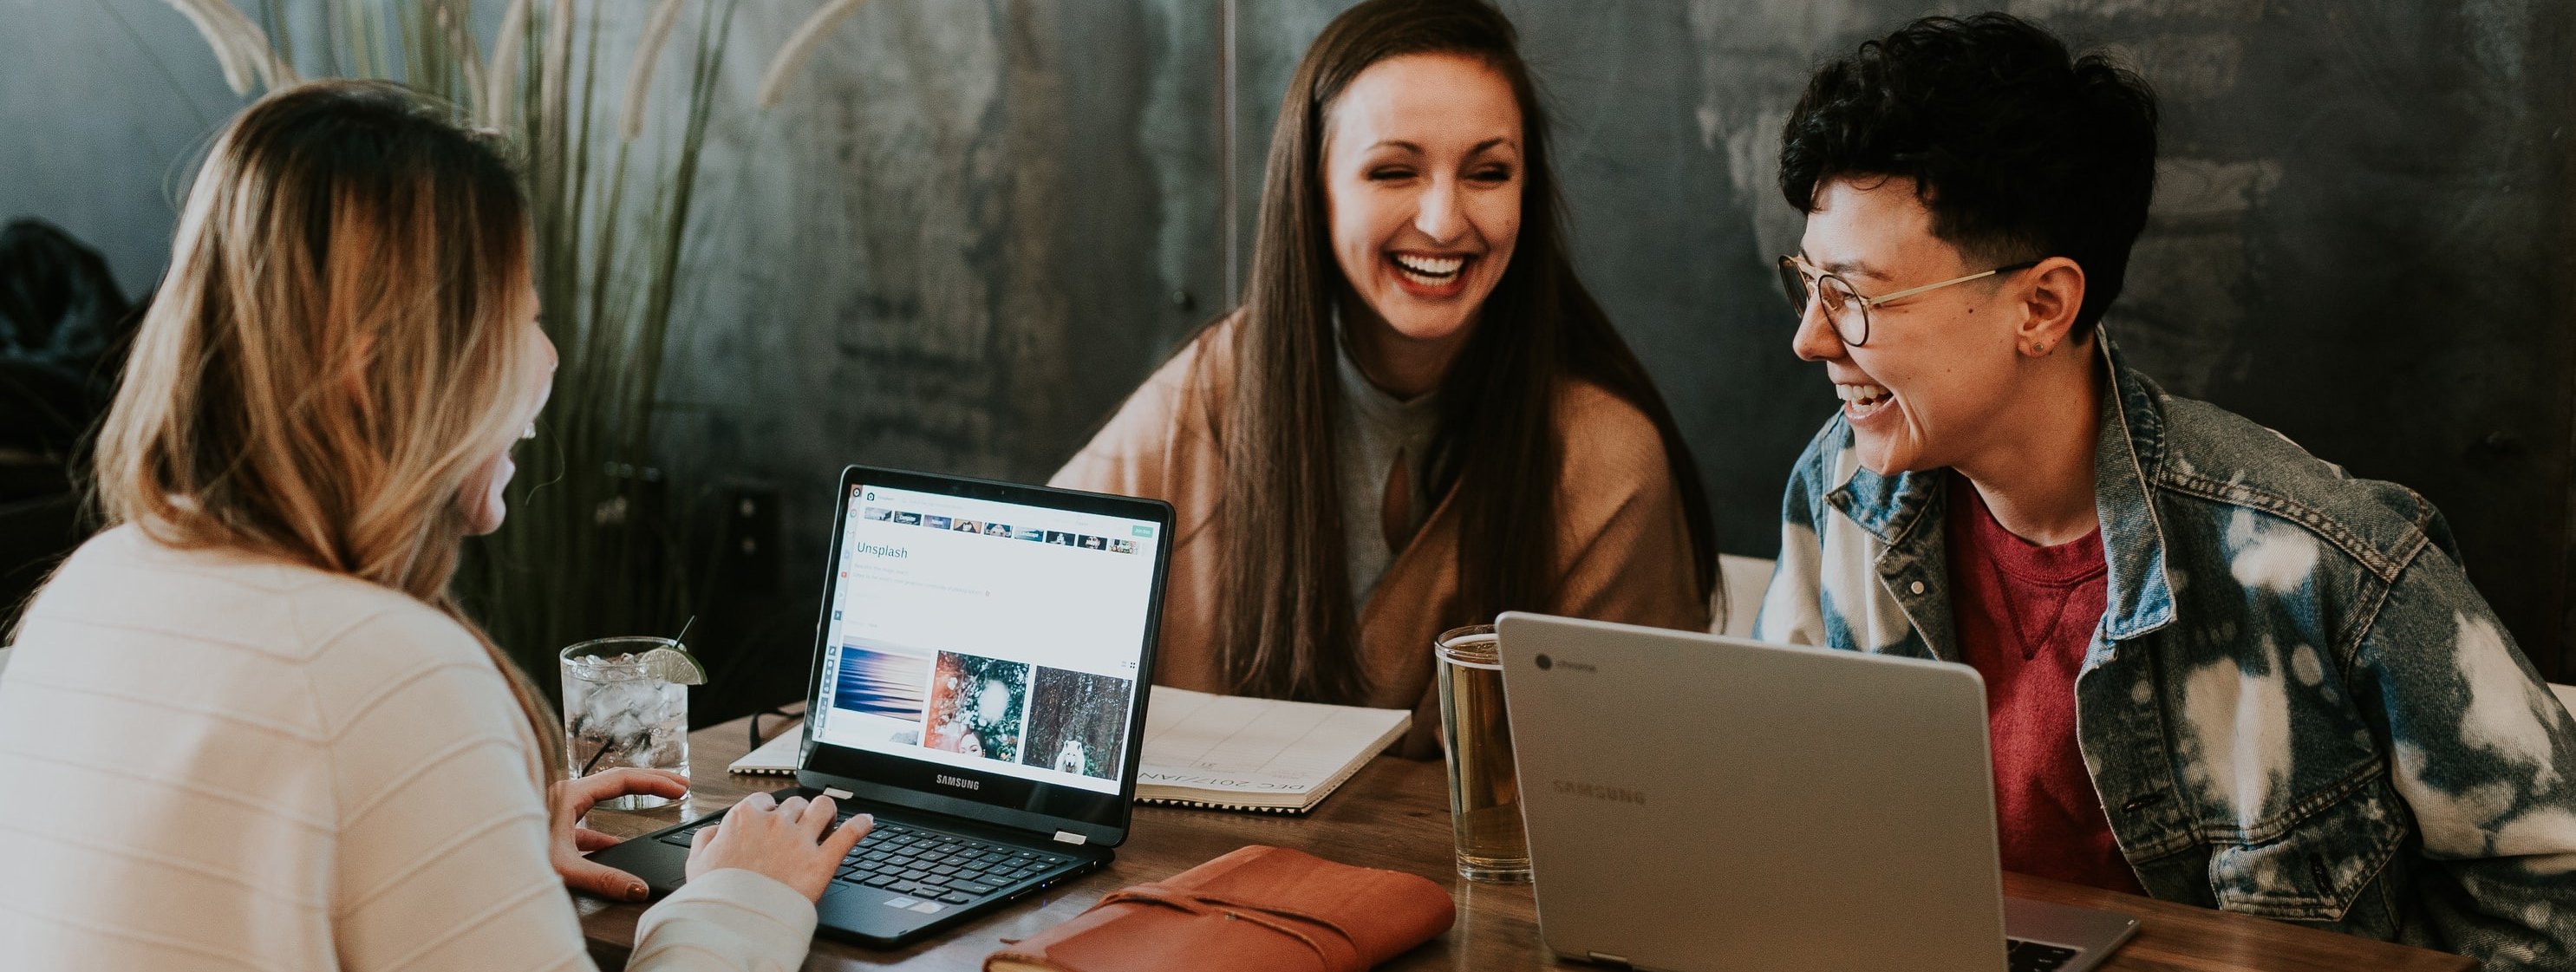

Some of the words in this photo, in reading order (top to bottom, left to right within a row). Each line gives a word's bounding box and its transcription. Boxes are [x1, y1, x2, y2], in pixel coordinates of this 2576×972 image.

[858, 541, 908, 559] Unsplash
[936, 773, 980, 791] SAMSUNG
[1553, 779, 1646, 806] SAMSUNG
